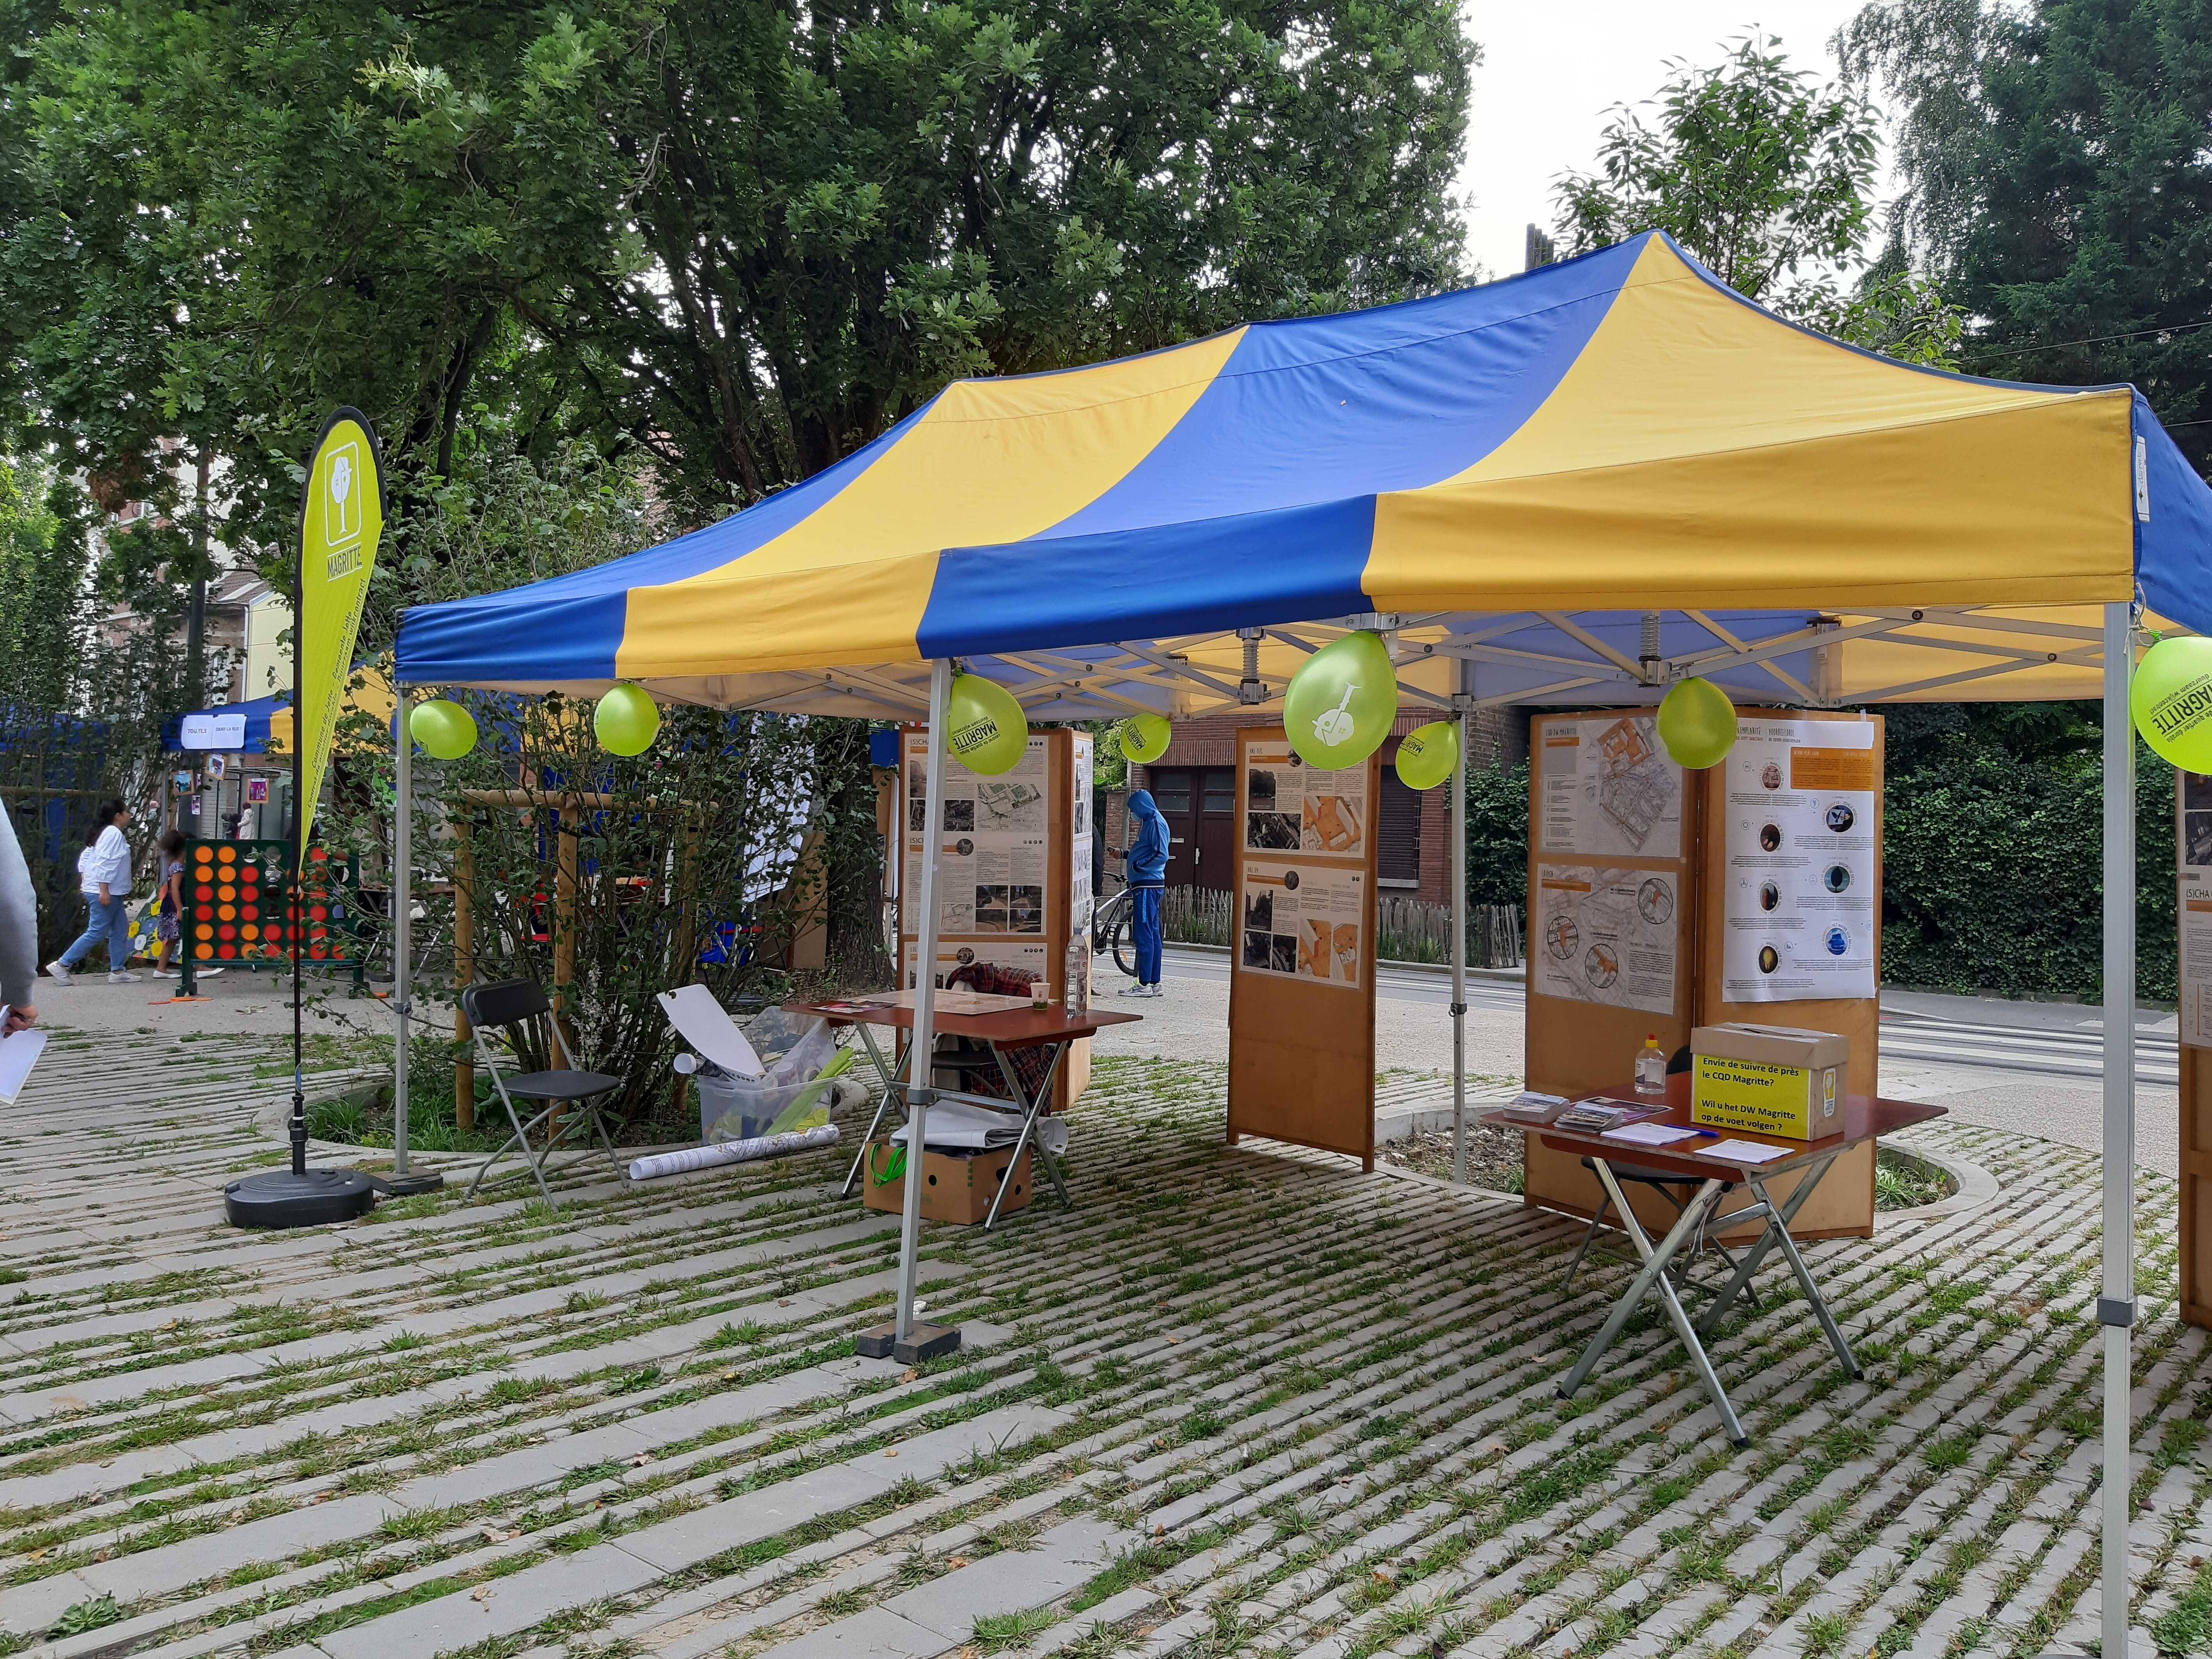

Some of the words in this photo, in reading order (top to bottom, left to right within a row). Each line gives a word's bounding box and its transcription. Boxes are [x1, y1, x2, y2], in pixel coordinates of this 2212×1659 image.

[327, 545, 362, 578] MAGRITTE
[349, 578, 366, 635] wijkcontract
[312, 726, 325, 769] Commune
[323, 713, 328, 725] de
[332, 635, 346, 680] Gemeente
[343, 611, 352, 633] Jette
[2180, 673, 2210, 693] duurzaam
[2149, 691, 2180, 715] wijkcontract
[1737, 726, 1761, 735] XEMPLARITÉ
[2183, 715, 2205, 732] quartier
[953, 721, 997, 749] MAGRITTE
[1127, 723, 1145, 750] MAGRITTE
[2166, 729, 2184, 743] durable
[1400, 738, 1424, 754] MAGRIT
[2186, 888, 2210, 899] (S)CHA
[1703, 1057, 1725, 1067] Envie
[1728, 1060, 1738, 1069] de
[1741, 1063, 1766, 1072] suivre
[1768, 1065, 1778, 1074] de
[1781, 1066, 1799, 1076] près
[1702, 1070, 1710, 1078] le
[1713, 1072, 1730, 1081] CQD
[1733, 1074, 1774, 1087] Magritte?
[1702, 1099, 1715, 1108] Wil
[1725, 1102, 1738, 1111] het
[1741, 1105, 1755, 1114] DW
[1758, 1108, 1796, 1120] Magritte
[1702, 1114, 1712, 1123] op
[1726, 1117, 1745, 1126] voet
[1747, 1120, 1775, 1130] volgen
